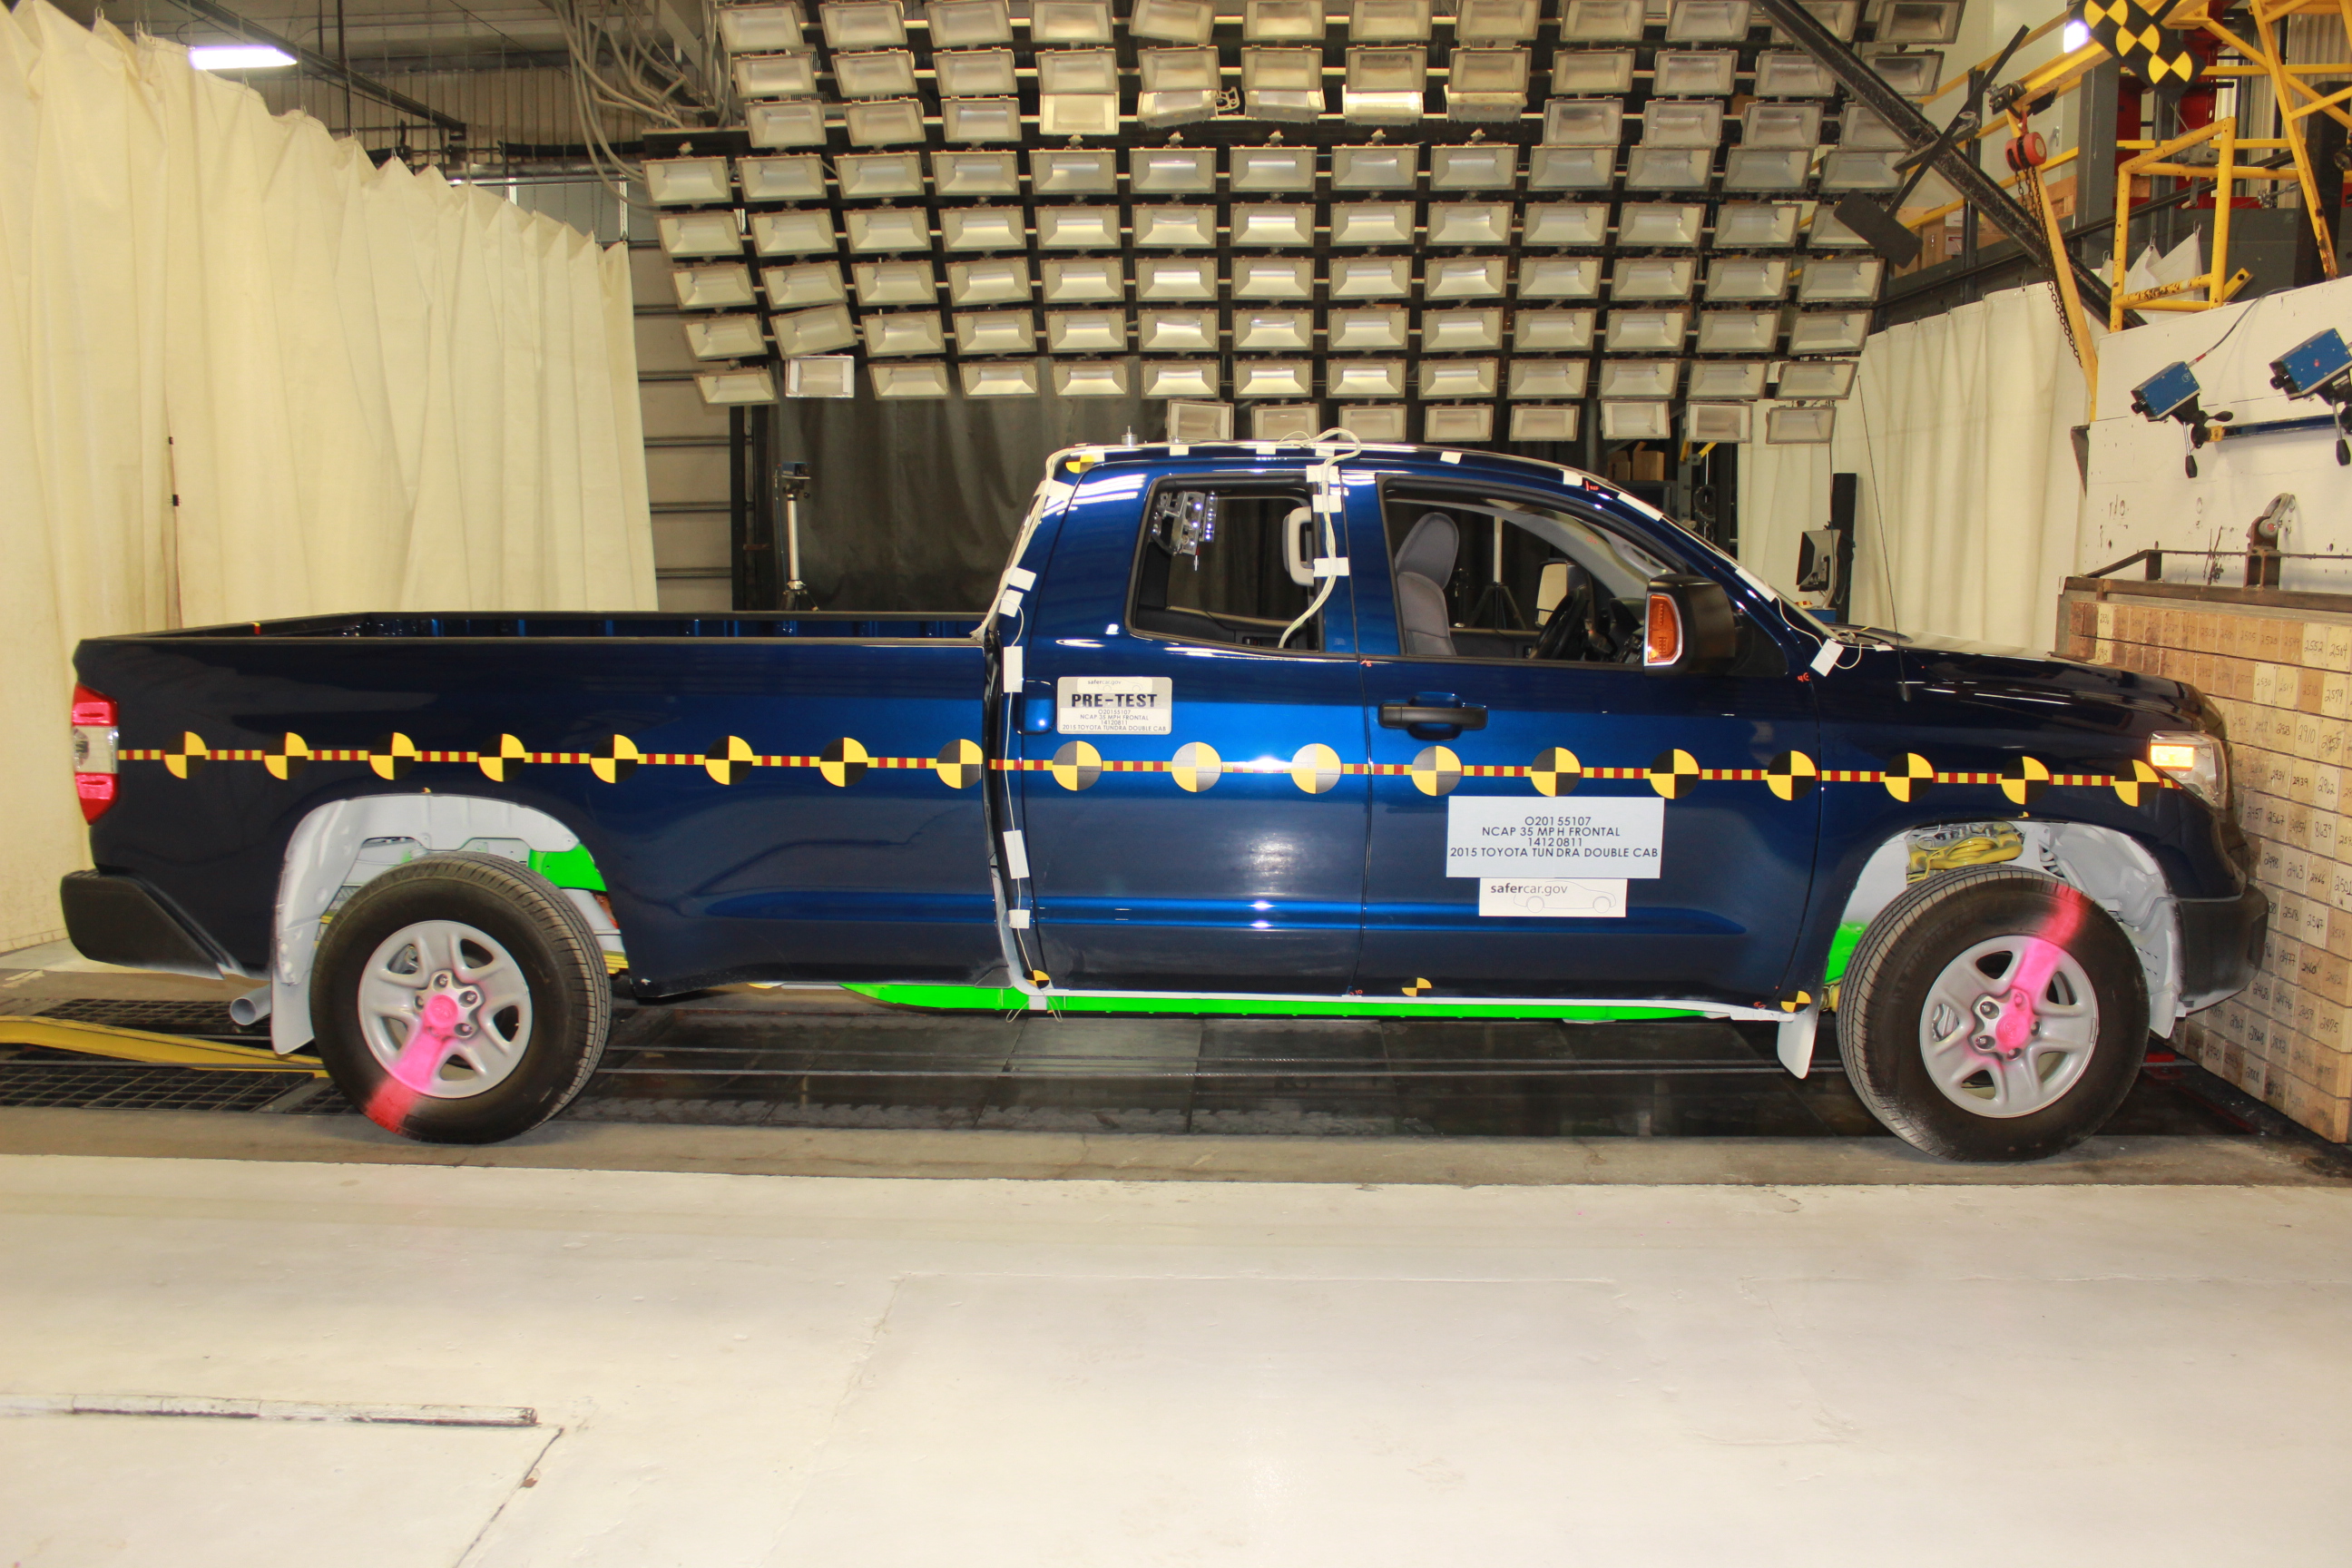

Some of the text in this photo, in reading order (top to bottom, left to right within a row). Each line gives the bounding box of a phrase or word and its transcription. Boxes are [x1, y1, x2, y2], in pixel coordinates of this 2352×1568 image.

[2304, 640, 2324, 652] 2552
[1072, 694, 1157, 707] PRE-TEST
[2325, 688, 2344, 705] 2579
[2298, 724, 2316, 743] 2910
[2292, 777, 2308, 789] 2939
[1482, 828, 1620, 837] NCAP 35 MPH FRONTAL
[1528, 838, 1583, 847] 14120811
[1450, 848, 1658, 858] 2015 TOYOTA TUNDRA DOUBLE CAB
[1491, 883, 1568, 897] safercar.gov
[2319, 1017, 2339, 1034] 2475
